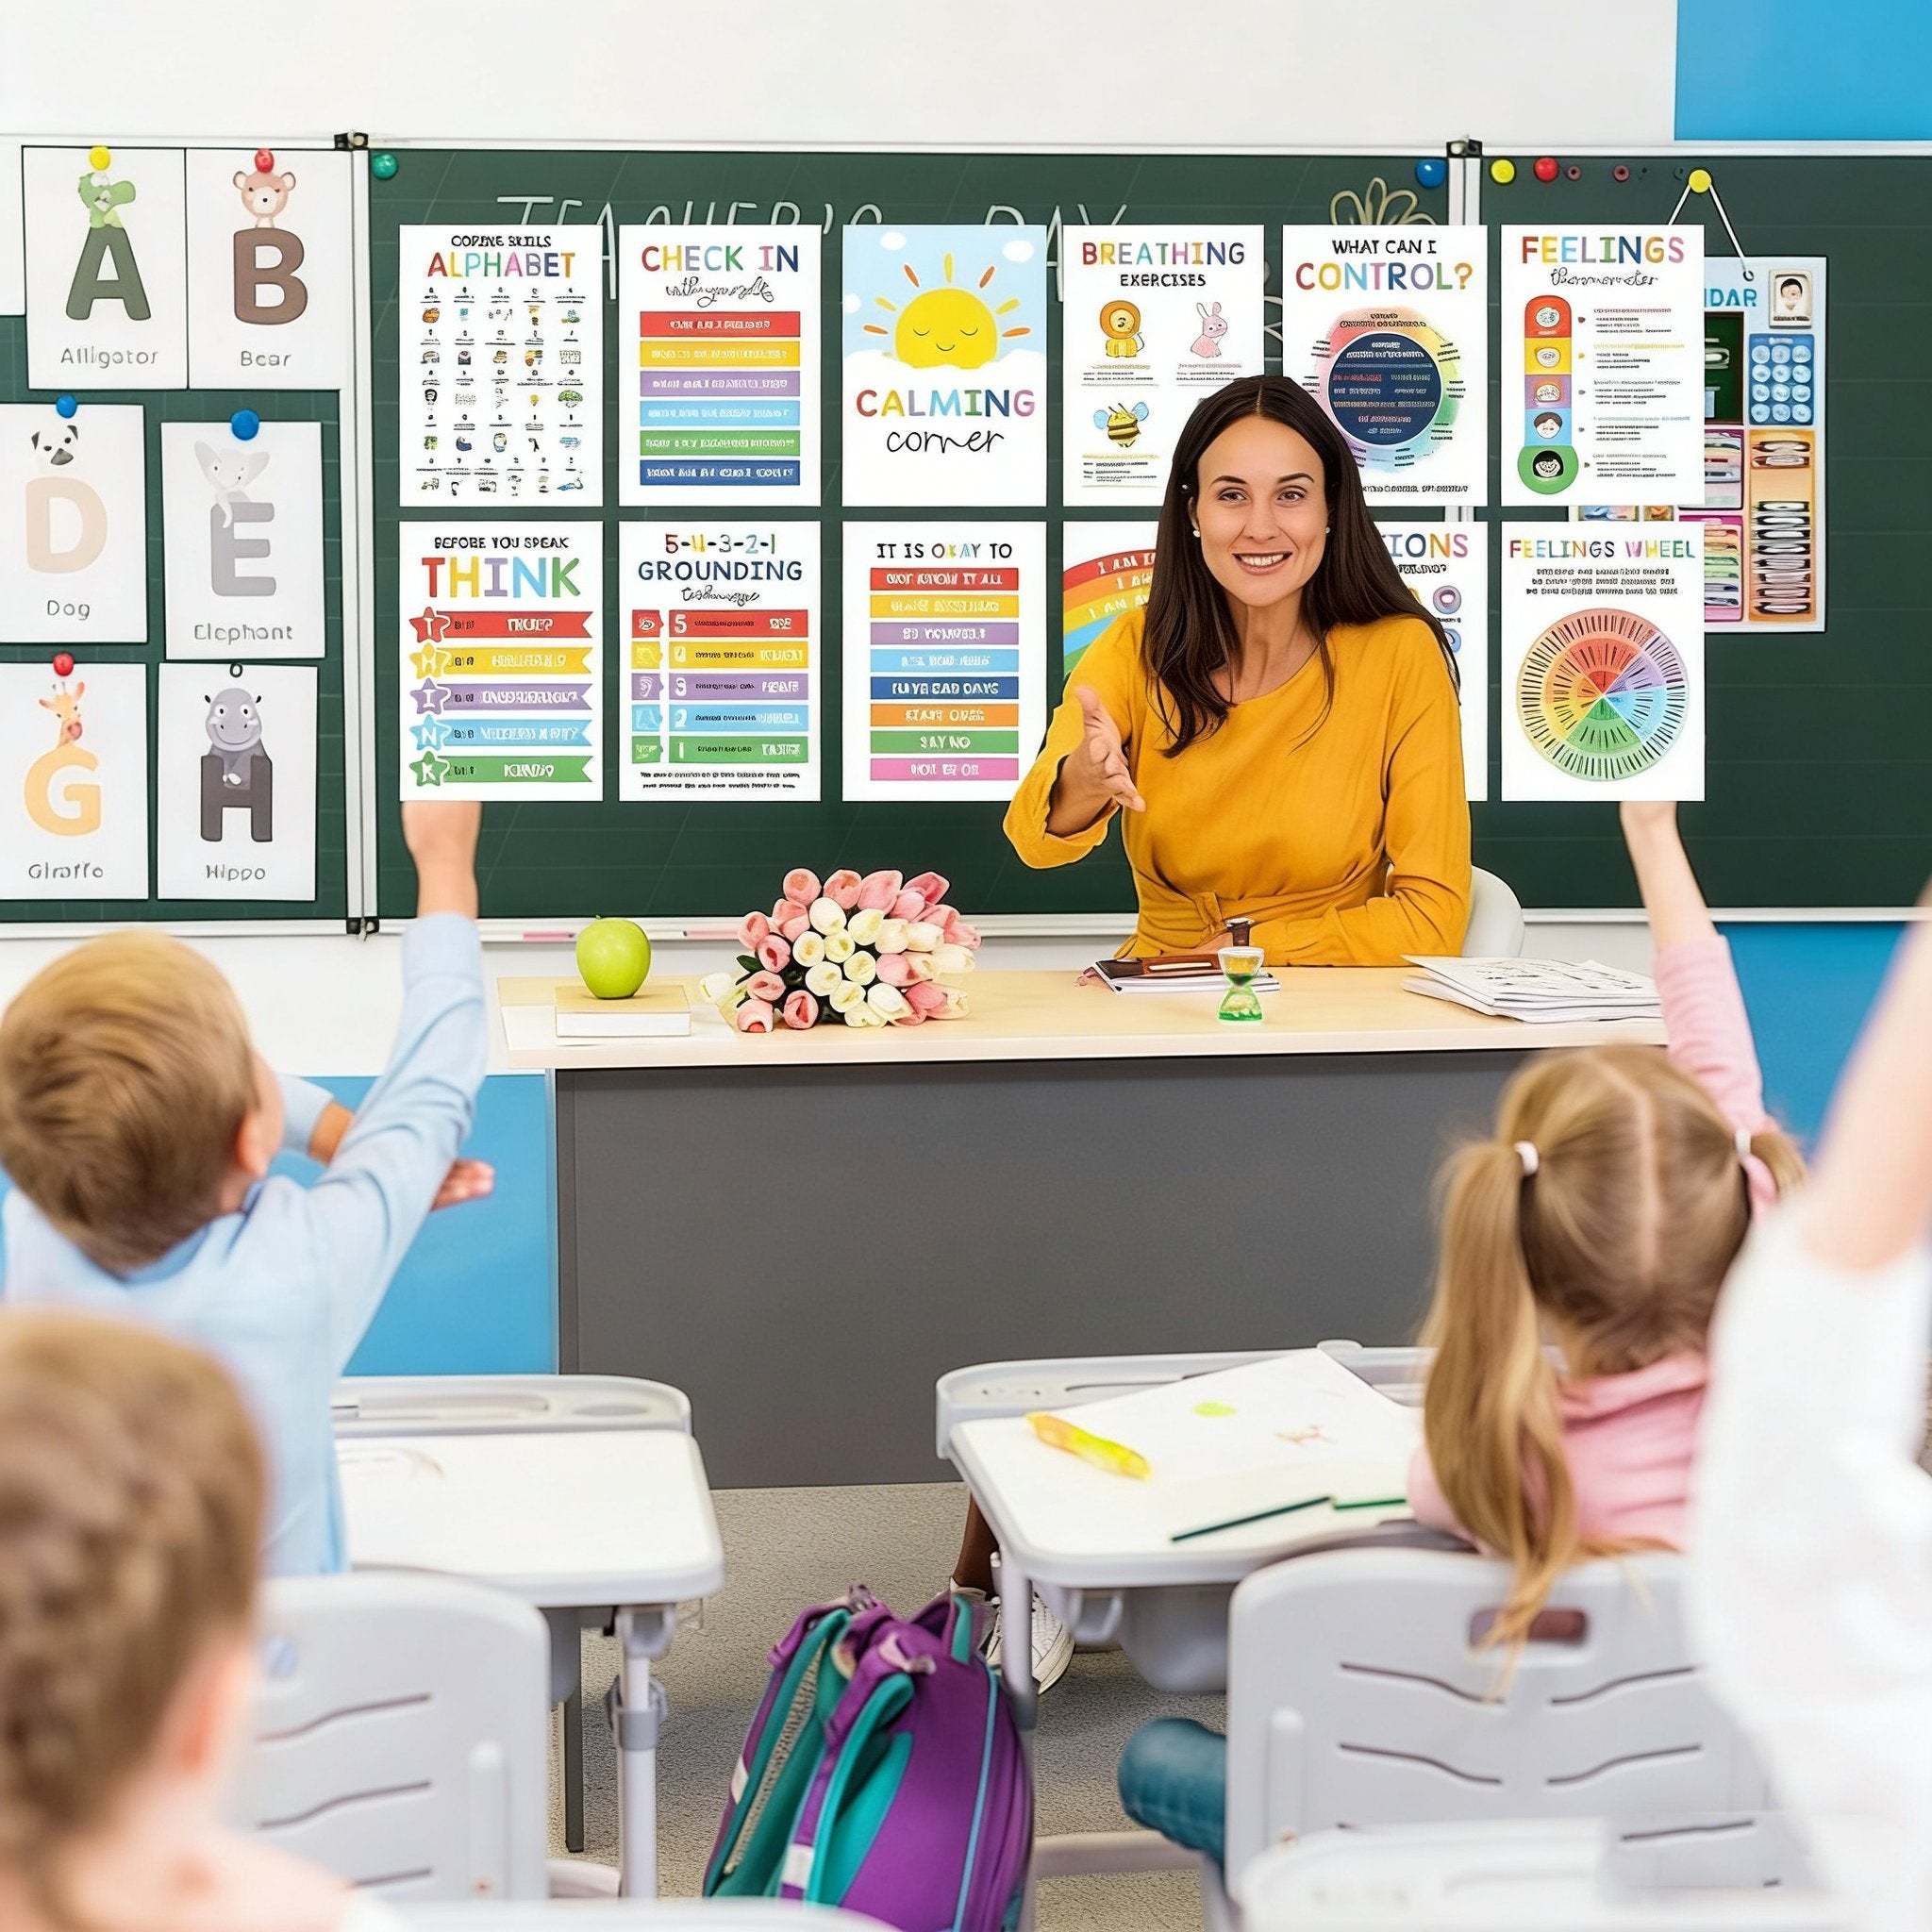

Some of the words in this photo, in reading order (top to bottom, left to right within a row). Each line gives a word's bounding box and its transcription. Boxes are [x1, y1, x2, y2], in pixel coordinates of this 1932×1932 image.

[641, 245, 743, 272] CHECK
[758, 245, 798, 273] IN
[1082, 242, 1244, 265] BREATHING
[1332, 240, 1379, 255] WHAT
[1386, 240, 1422, 254] CAN
[1427, 241, 1437, 254] I
[1523, 236, 1684, 264] FEELINGS
[65, 226, 152, 321] A
[233, 227, 308, 325] B
[427, 251, 575, 278] ALPHABET
[1296, 262, 1474, 291] CONTROL?
[1121, 274, 1206, 287] EXERCISES
[1705, 287, 1757, 308] DAR
[857, 389, 1035, 417] CALMING
[887, 430, 1004, 454] corner
[25, 476, 108, 574] D
[210, 502, 275, 596] E
[491, 537, 519, 549] YOU
[525, 537, 569, 548] SPEAK
[876, 543, 896, 558] IT
[905, 543, 924, 558] IS
[931, 543, 981, 558] OKAY
[990, 543, 1012, 558] TO
[1382, 533, 1469, 558] IONS
[1510, 540, 1614, 558] FEELINGS
[1625, 540, 1695, 558] WHEEL
[422, 556, 581, 598] THINK
[639, 560, 802, 581] GROUNDING
[47, 600, 90, 621] Dog
[675, 614, 687, 633] 5
[672, 708, 689, 728] 2
[421, 727, 438, 745] N
[675, 741, 685, 759] 1
[25, 745, 102, 837] G
[201, 754, 272, 842] H
